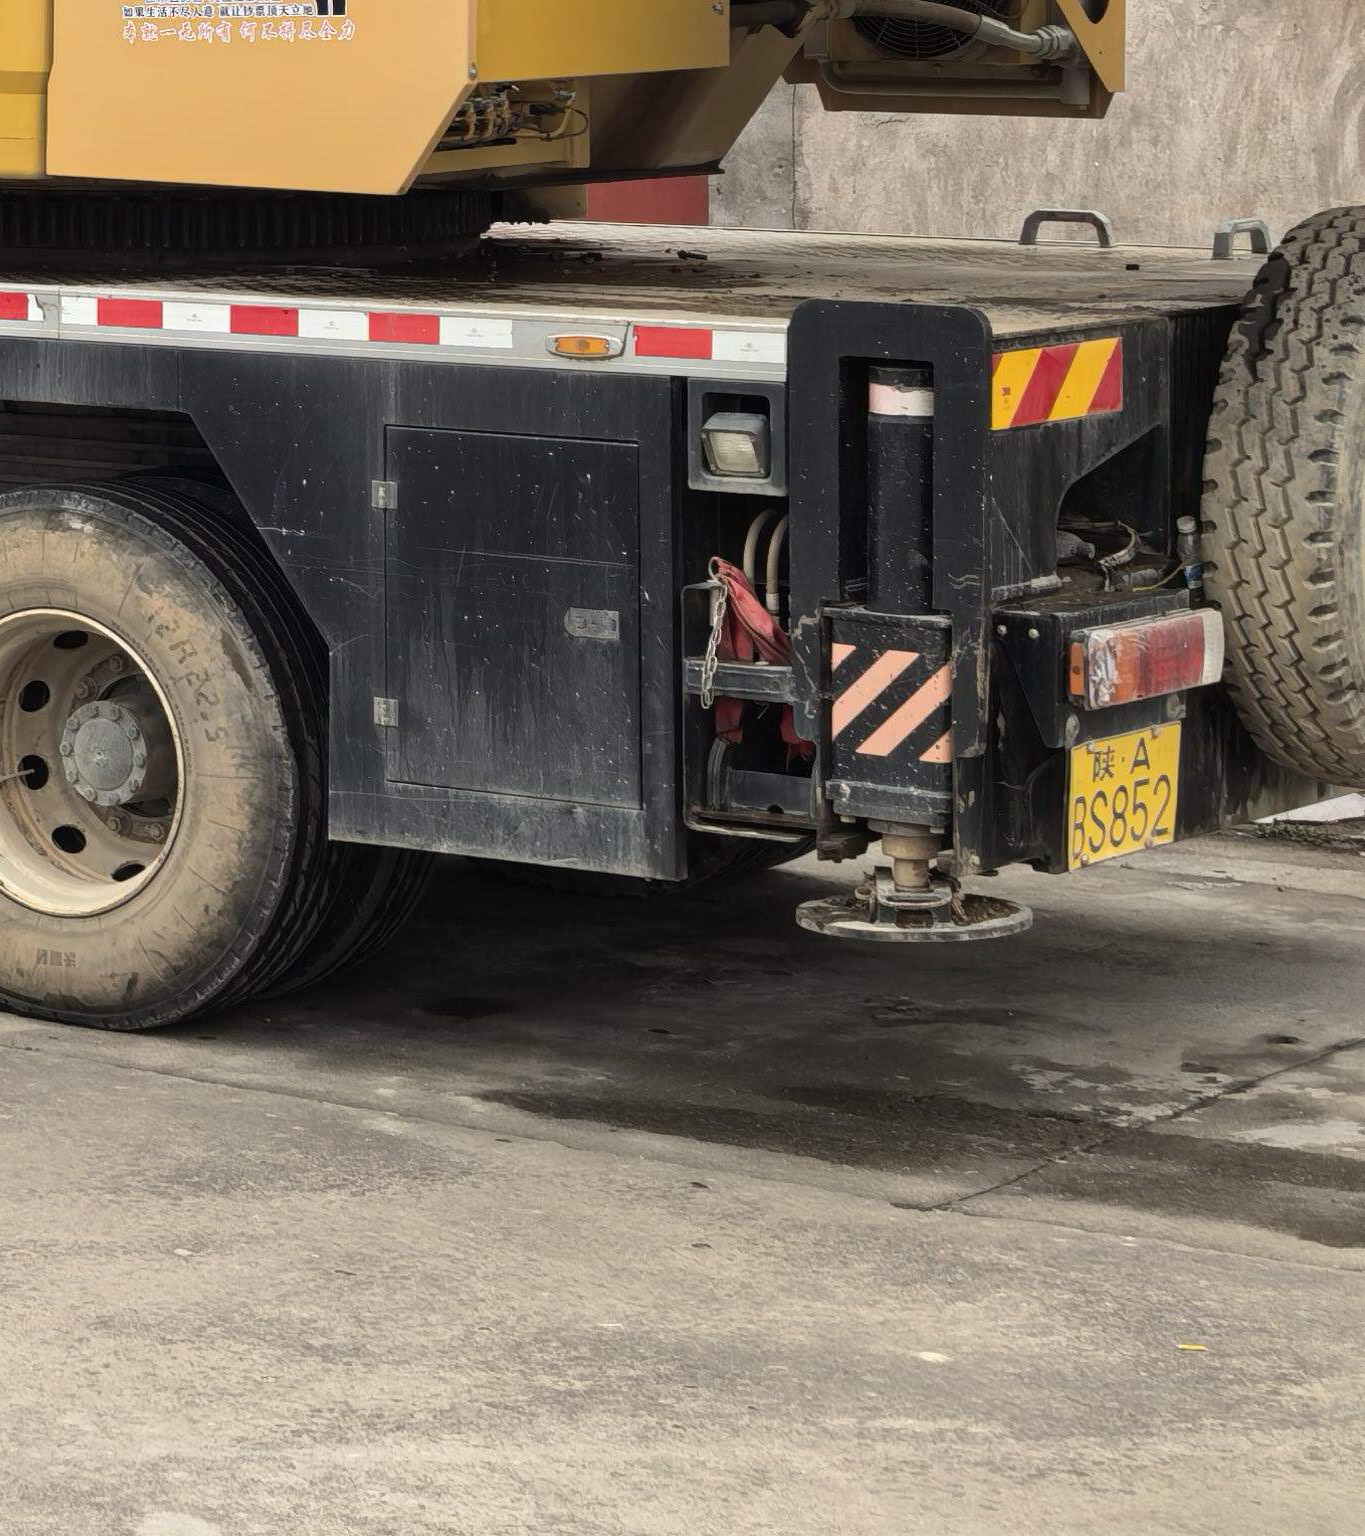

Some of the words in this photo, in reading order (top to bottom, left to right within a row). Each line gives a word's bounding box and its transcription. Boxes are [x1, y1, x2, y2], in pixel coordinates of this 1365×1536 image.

[122, 5, 214, 19] 如果生活不尽人意
